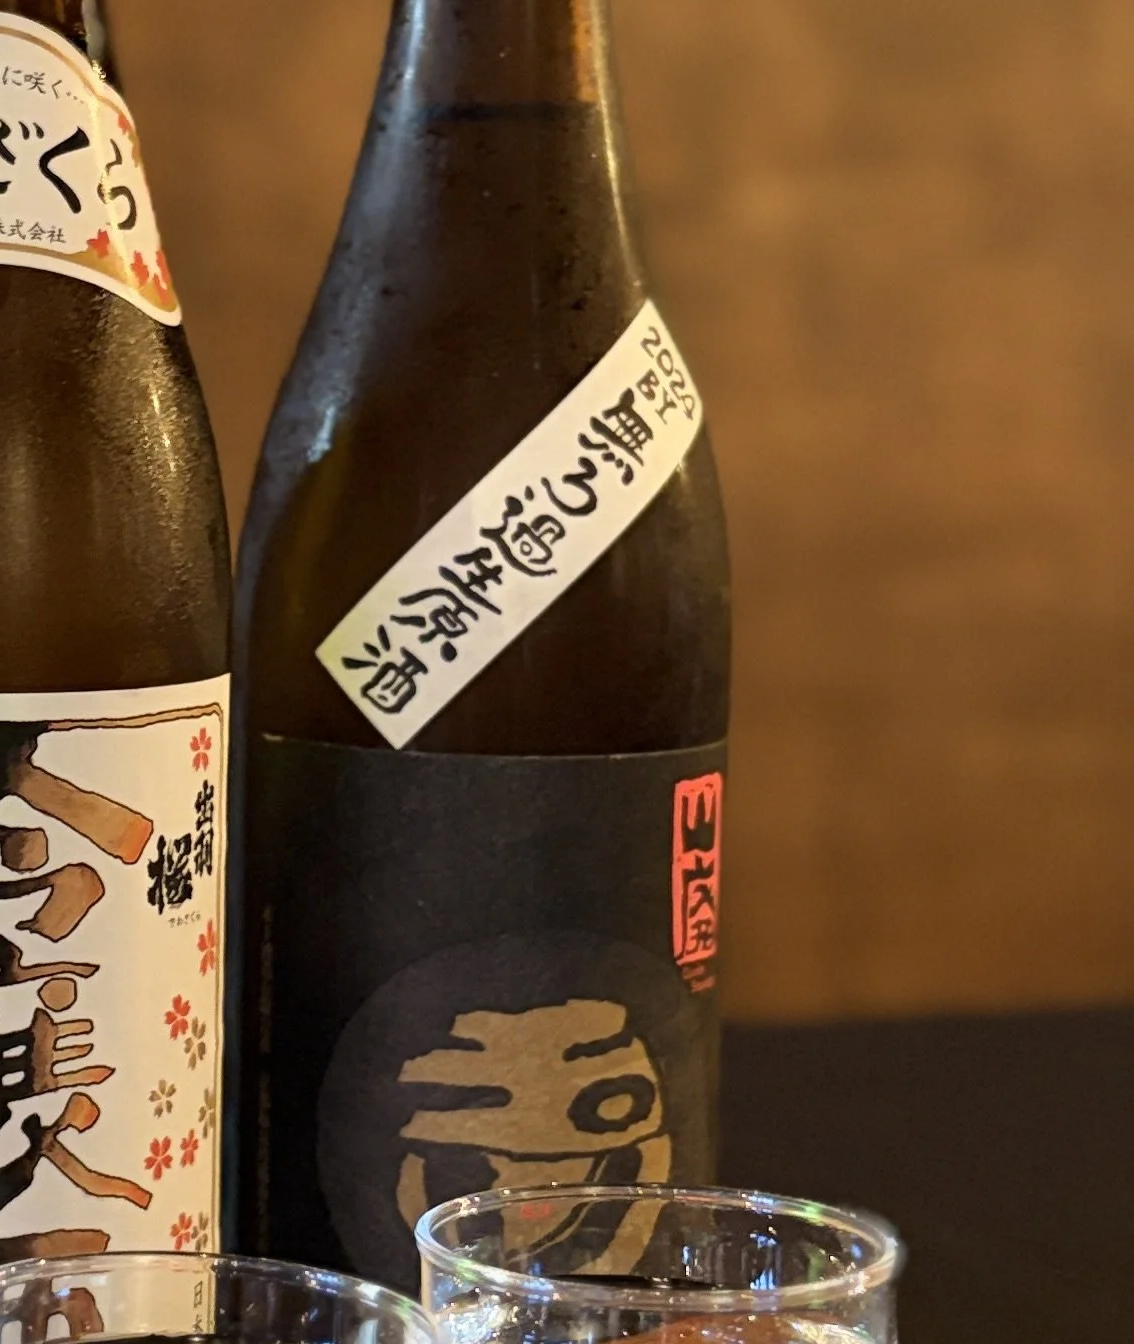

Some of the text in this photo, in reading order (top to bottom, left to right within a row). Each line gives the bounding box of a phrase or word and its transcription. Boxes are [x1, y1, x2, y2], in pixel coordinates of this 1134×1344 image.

[635, 367, 677, 425] BY
[341, 387, 654, 715] 無ろ過生原酒
